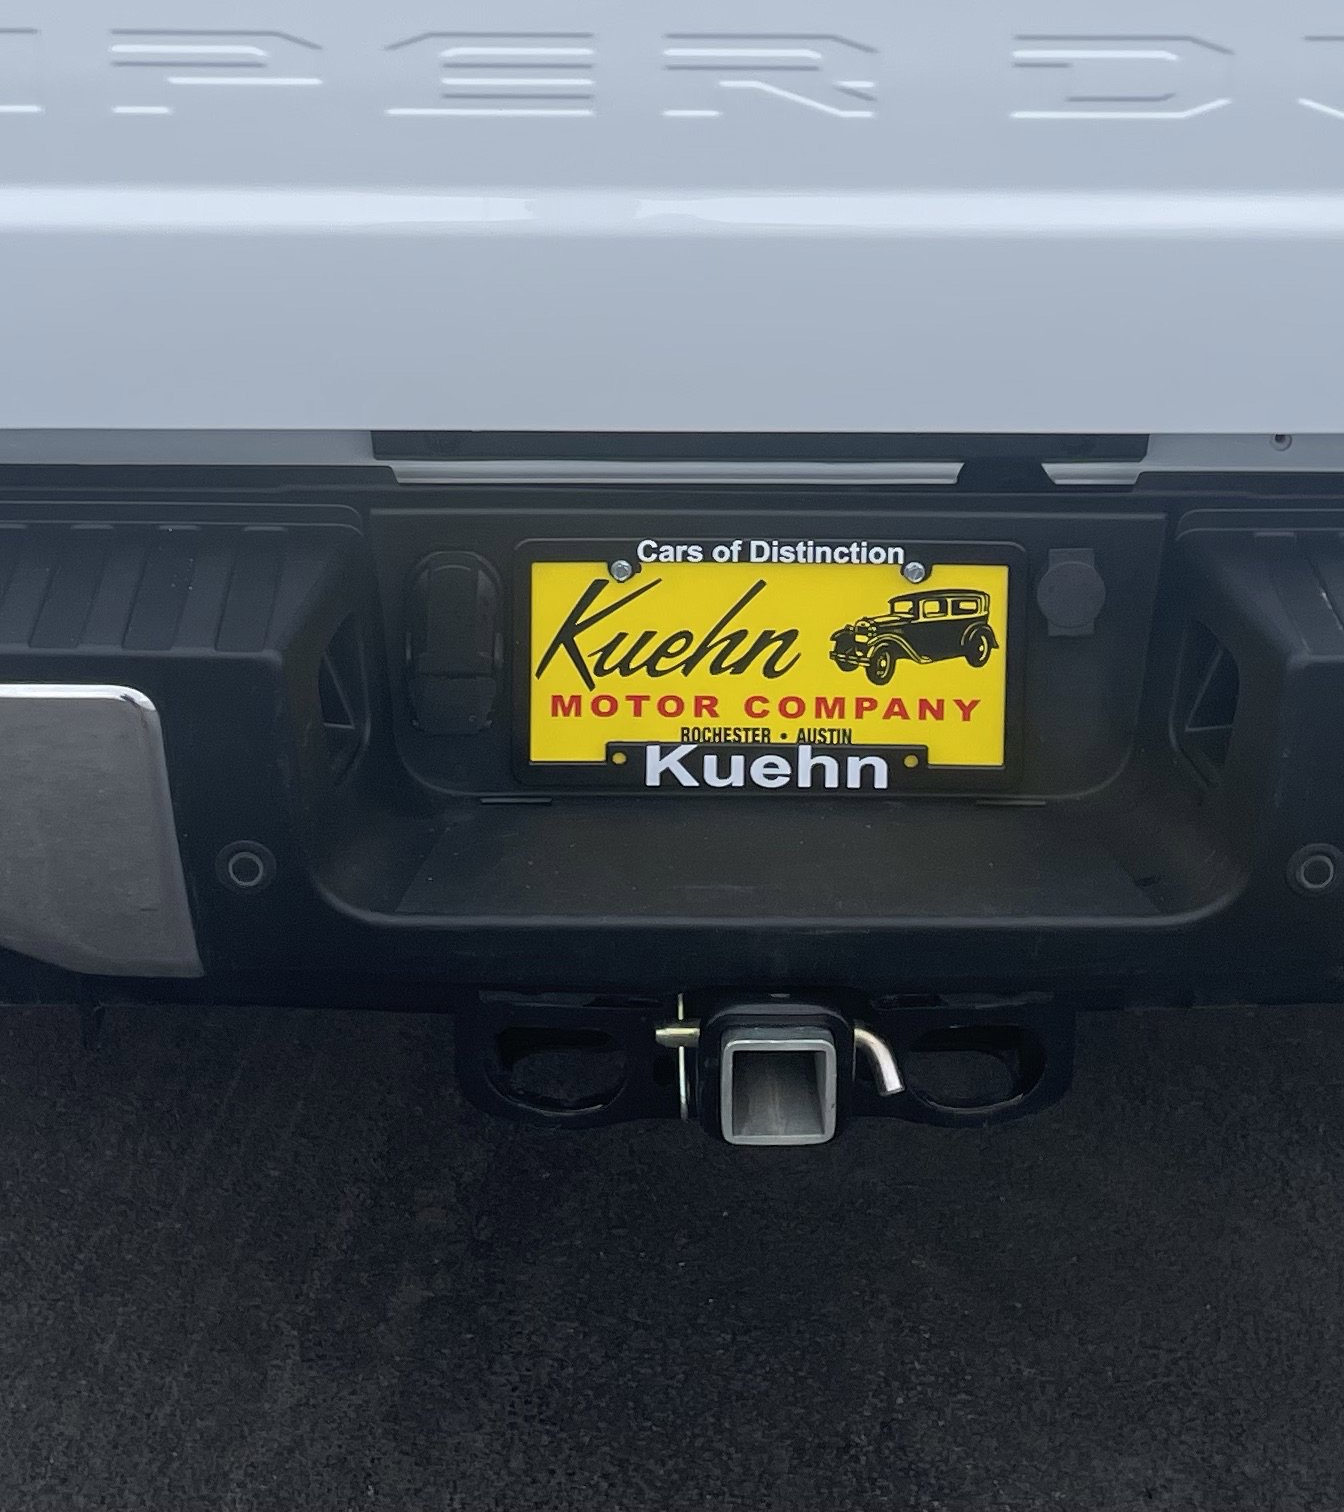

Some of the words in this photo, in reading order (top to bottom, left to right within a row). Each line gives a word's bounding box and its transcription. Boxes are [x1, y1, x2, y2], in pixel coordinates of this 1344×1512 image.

[637, 539, 703, 564] Cars
[712, 540, 743, 563] of
[749, 541, 905, 565] Distinction
[535, 579, 802, 692] Kuehn
[550, 694, 720, 719] MOTOR
[743, 695, 981, 722] COMPANY
[681, 727, 771, 744] ROCHESTER
[797, 728, 853, 745] AUSTIN
[644, 744, 889, 789] Kuehn
